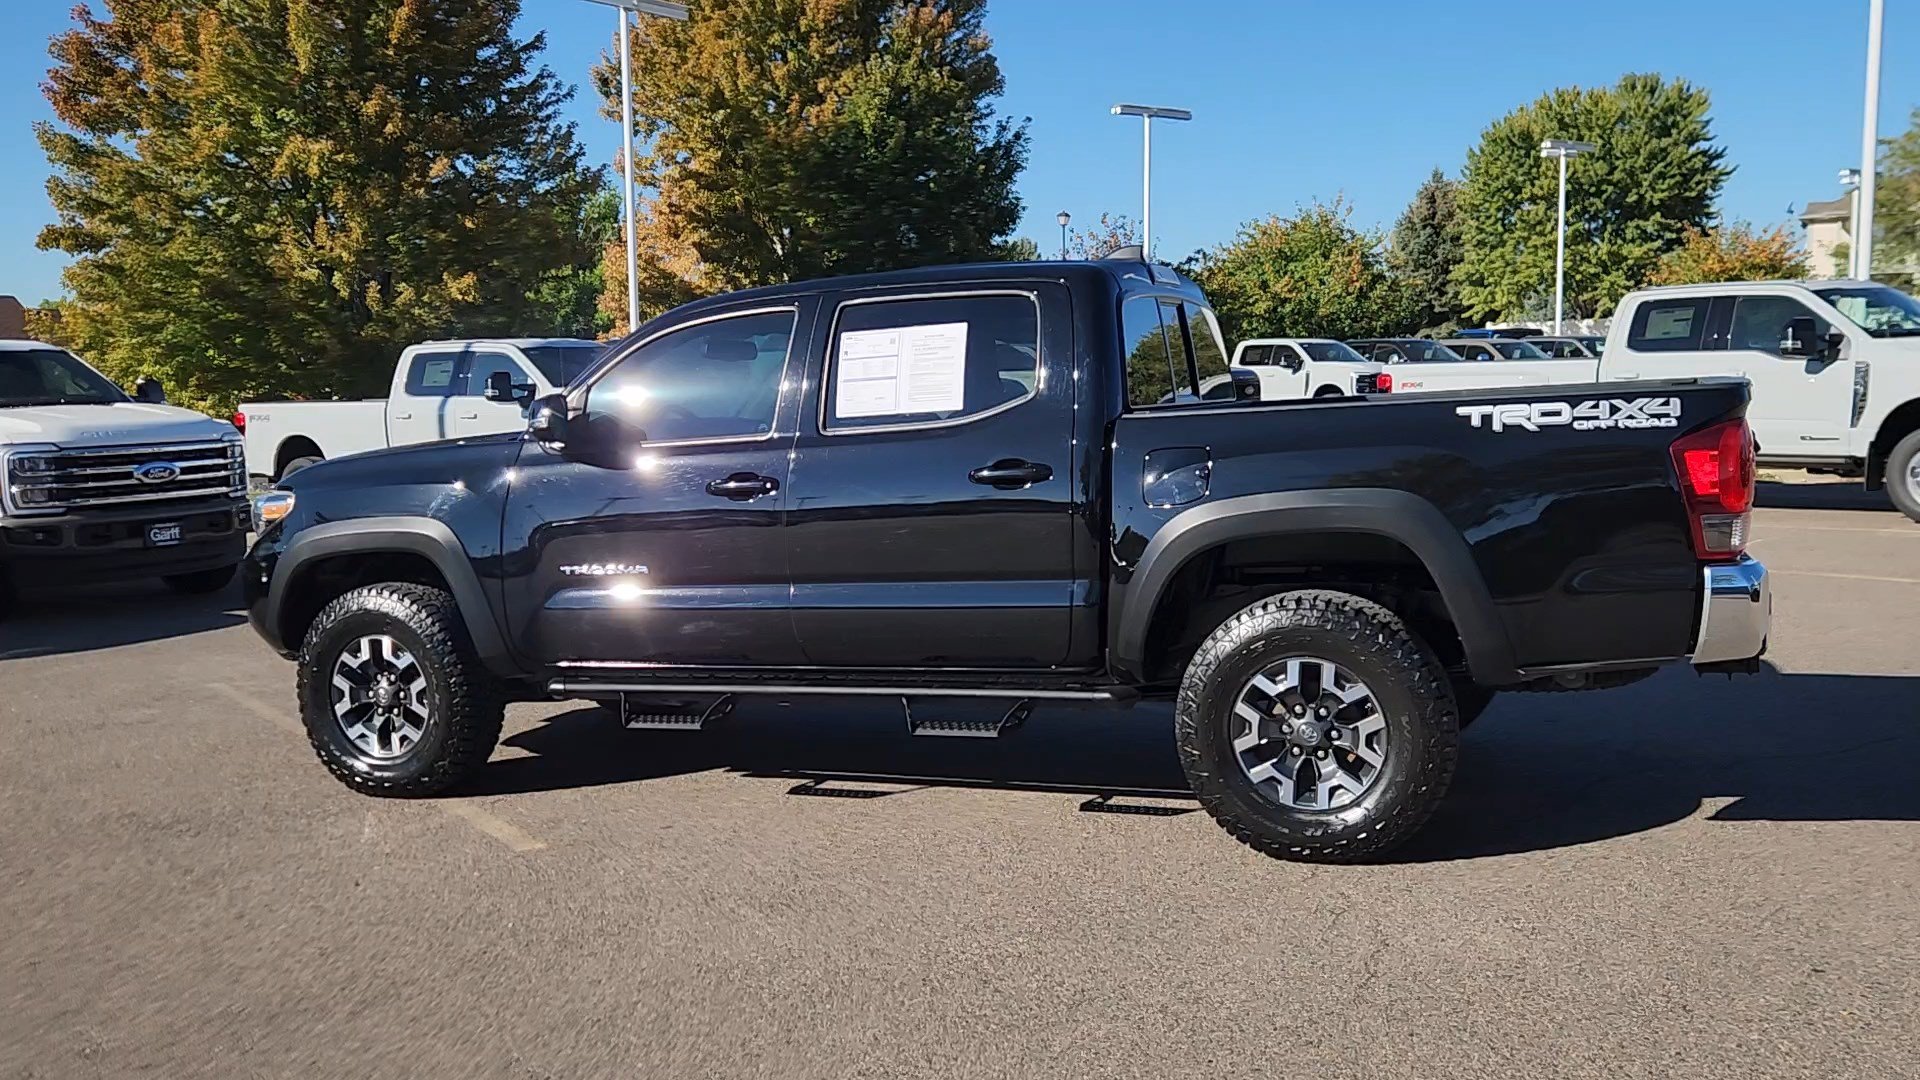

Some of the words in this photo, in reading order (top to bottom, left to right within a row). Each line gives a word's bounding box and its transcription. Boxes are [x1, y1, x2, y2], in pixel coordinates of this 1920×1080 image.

[1456, 401, 1573, 432] TRD
[1573, 397, 1681, 420] 4X4
[1573, 420, 1617, 430] OFF
[1618, 417, 1678, 428] ROAD
[148, 468, 171, 478] Ford
